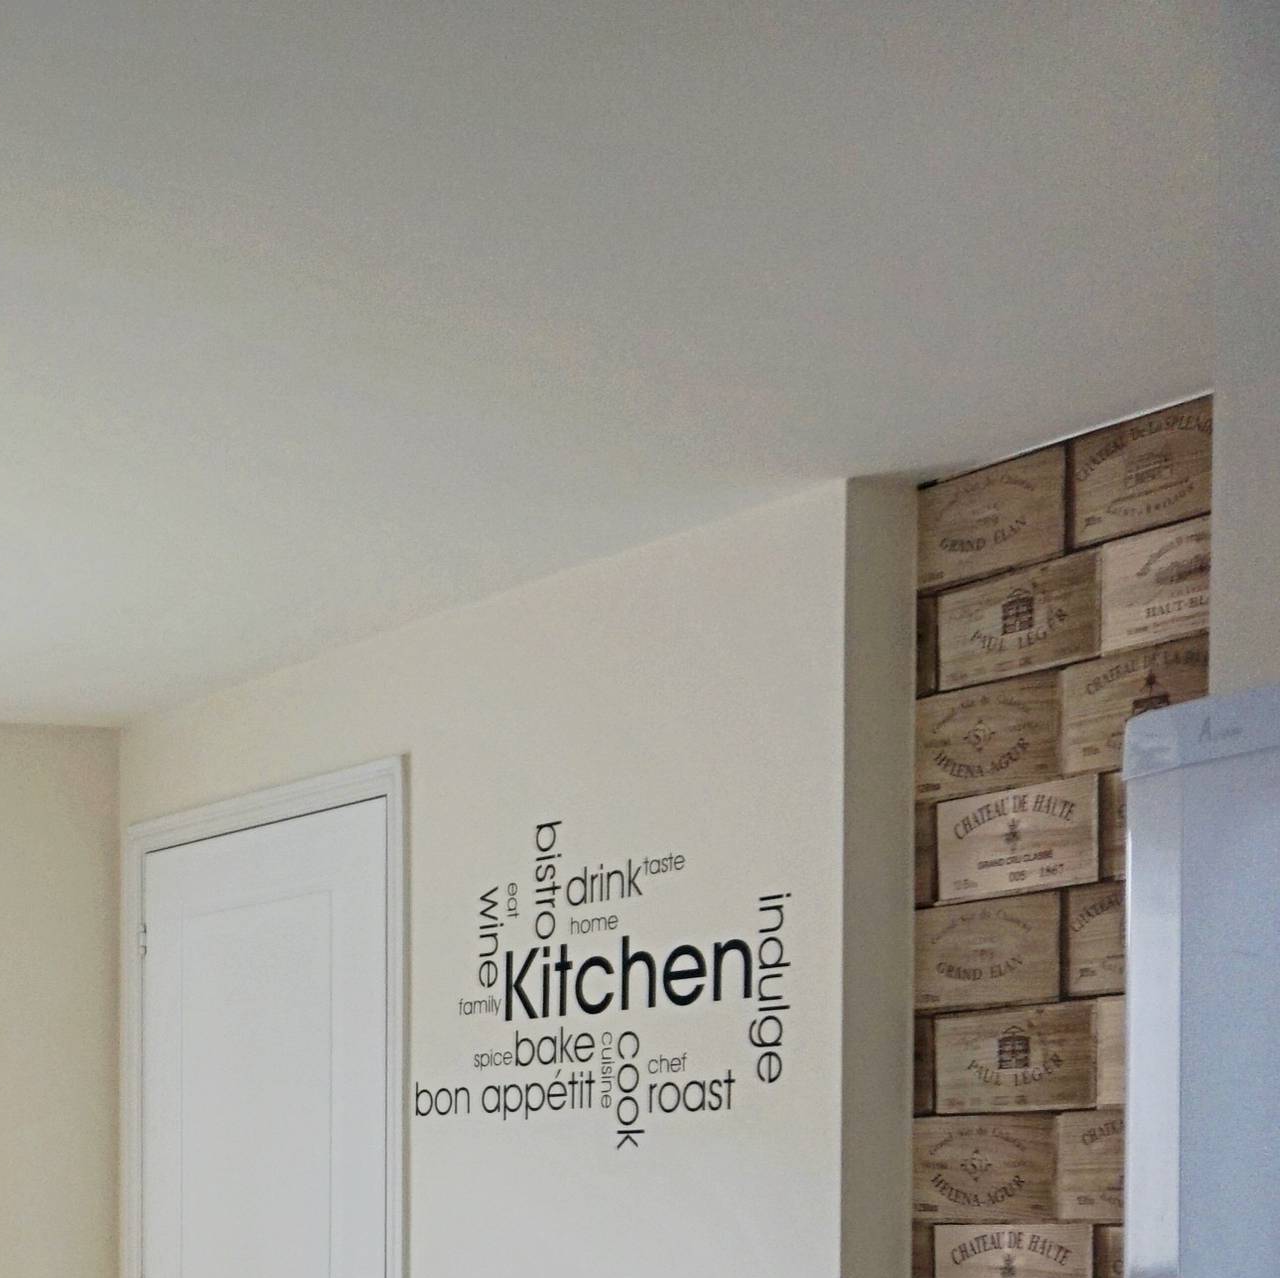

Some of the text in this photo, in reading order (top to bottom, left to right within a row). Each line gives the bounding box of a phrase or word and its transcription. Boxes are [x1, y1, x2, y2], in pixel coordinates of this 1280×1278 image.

[1012, 794, 1028, 813] DE
[1034, 794, 1076, 821] HAUTE
[535, 820, 563, 940] bistro
[566, 859, 643, 906] drink
[643, 853, 686, 876] taste
[506, 882, 520, 919] eat
[478, 886, 504, 988] wine
[570, 914, 619, 935] home
[504, 935, 753, 1022] Kitchen
[749, 892, 791, 1084] indulge
[936, 962, 983, 981] GRAND
[458, 995, 502, 1016] family
[473, 1049, 512, 1071] spice
[515, 1025, 595, 1068] bake
[647, 1052, 688, 1074] chef
[600, 1031, 615, 1109] cuisine
[616, 1031, 645, 1150] cook
[649, 1069, 736, 1113] roast
[415, 1069, 596, 1120] bon appétit
[1008, 1231, 1024, 1249] DE
[1028, 1234, 1073, 1266] HAUTE
